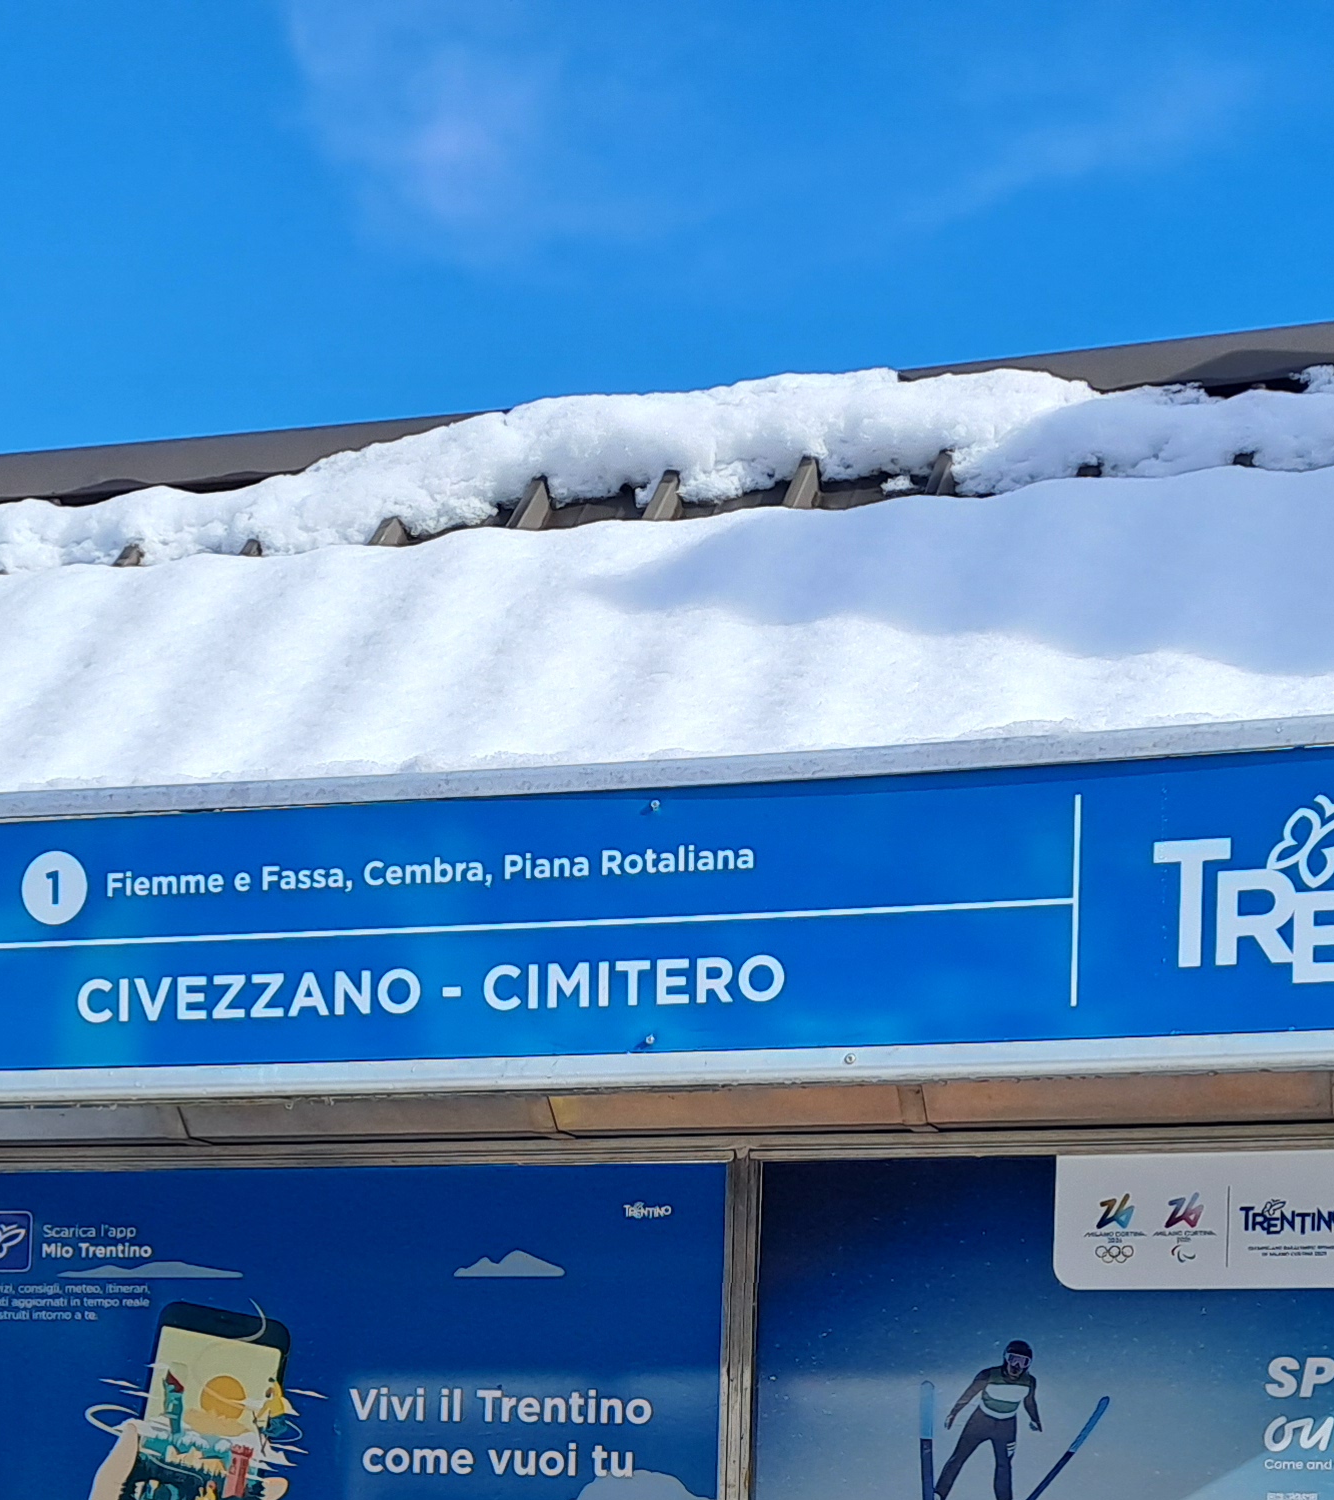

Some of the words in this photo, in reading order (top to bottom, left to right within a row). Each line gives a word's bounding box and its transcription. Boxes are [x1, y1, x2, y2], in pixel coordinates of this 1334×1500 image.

[105, 869, 225, 899] Fiemme
[233, 873, 252, 893] e
[260, 862, 354, 895] Fassa,
[362, 852, 494, 890] Cembra,
[504, 849, 589, 881] Piana
[601, 844, 756, 878] Rotaliana
[43, 869, 62, 907] 1
[76, 967, 423, 1025] CIVEZZANO
[482, 953, 787, 1012] CIMITERO
[623, 1204, 671, 1219] TRENTINO
[42, 1224, 96, 1238] Scarica
[101, 1224, 137, 1239] l'app
[42, 1243, 73, 1258] Mio
[78, 1243, 153, 1258] Trentino
[18, 1283, 62, 1296] consigli,
[65, 1285, 103, 1295] meteo,
[106, 1283, 151, 1295] itinerari,
[11, 1298, 67, 1309] aggiornati
[70, 1298, 80, 1307] in
[83, 1298, 119, 1309] tempo
[122, 1298, 150, 1307] reale
[32, 1310, 71, 1320] intorno
[74, 1312, 82, 1320] a
[349, 1387, 425, 1421] Vivi
[440, 1387, 463, 1422] il
[476, 1389, 653, 1425] Trentino
[362, 1447, 474, 1475] come
[488, 1442, 577, 1477] vuoi
[592, 1445, 633, 1478] tu
[1264, 1459, 1303, 1470] Come
[1306, 1459, 1332, 1470] and
